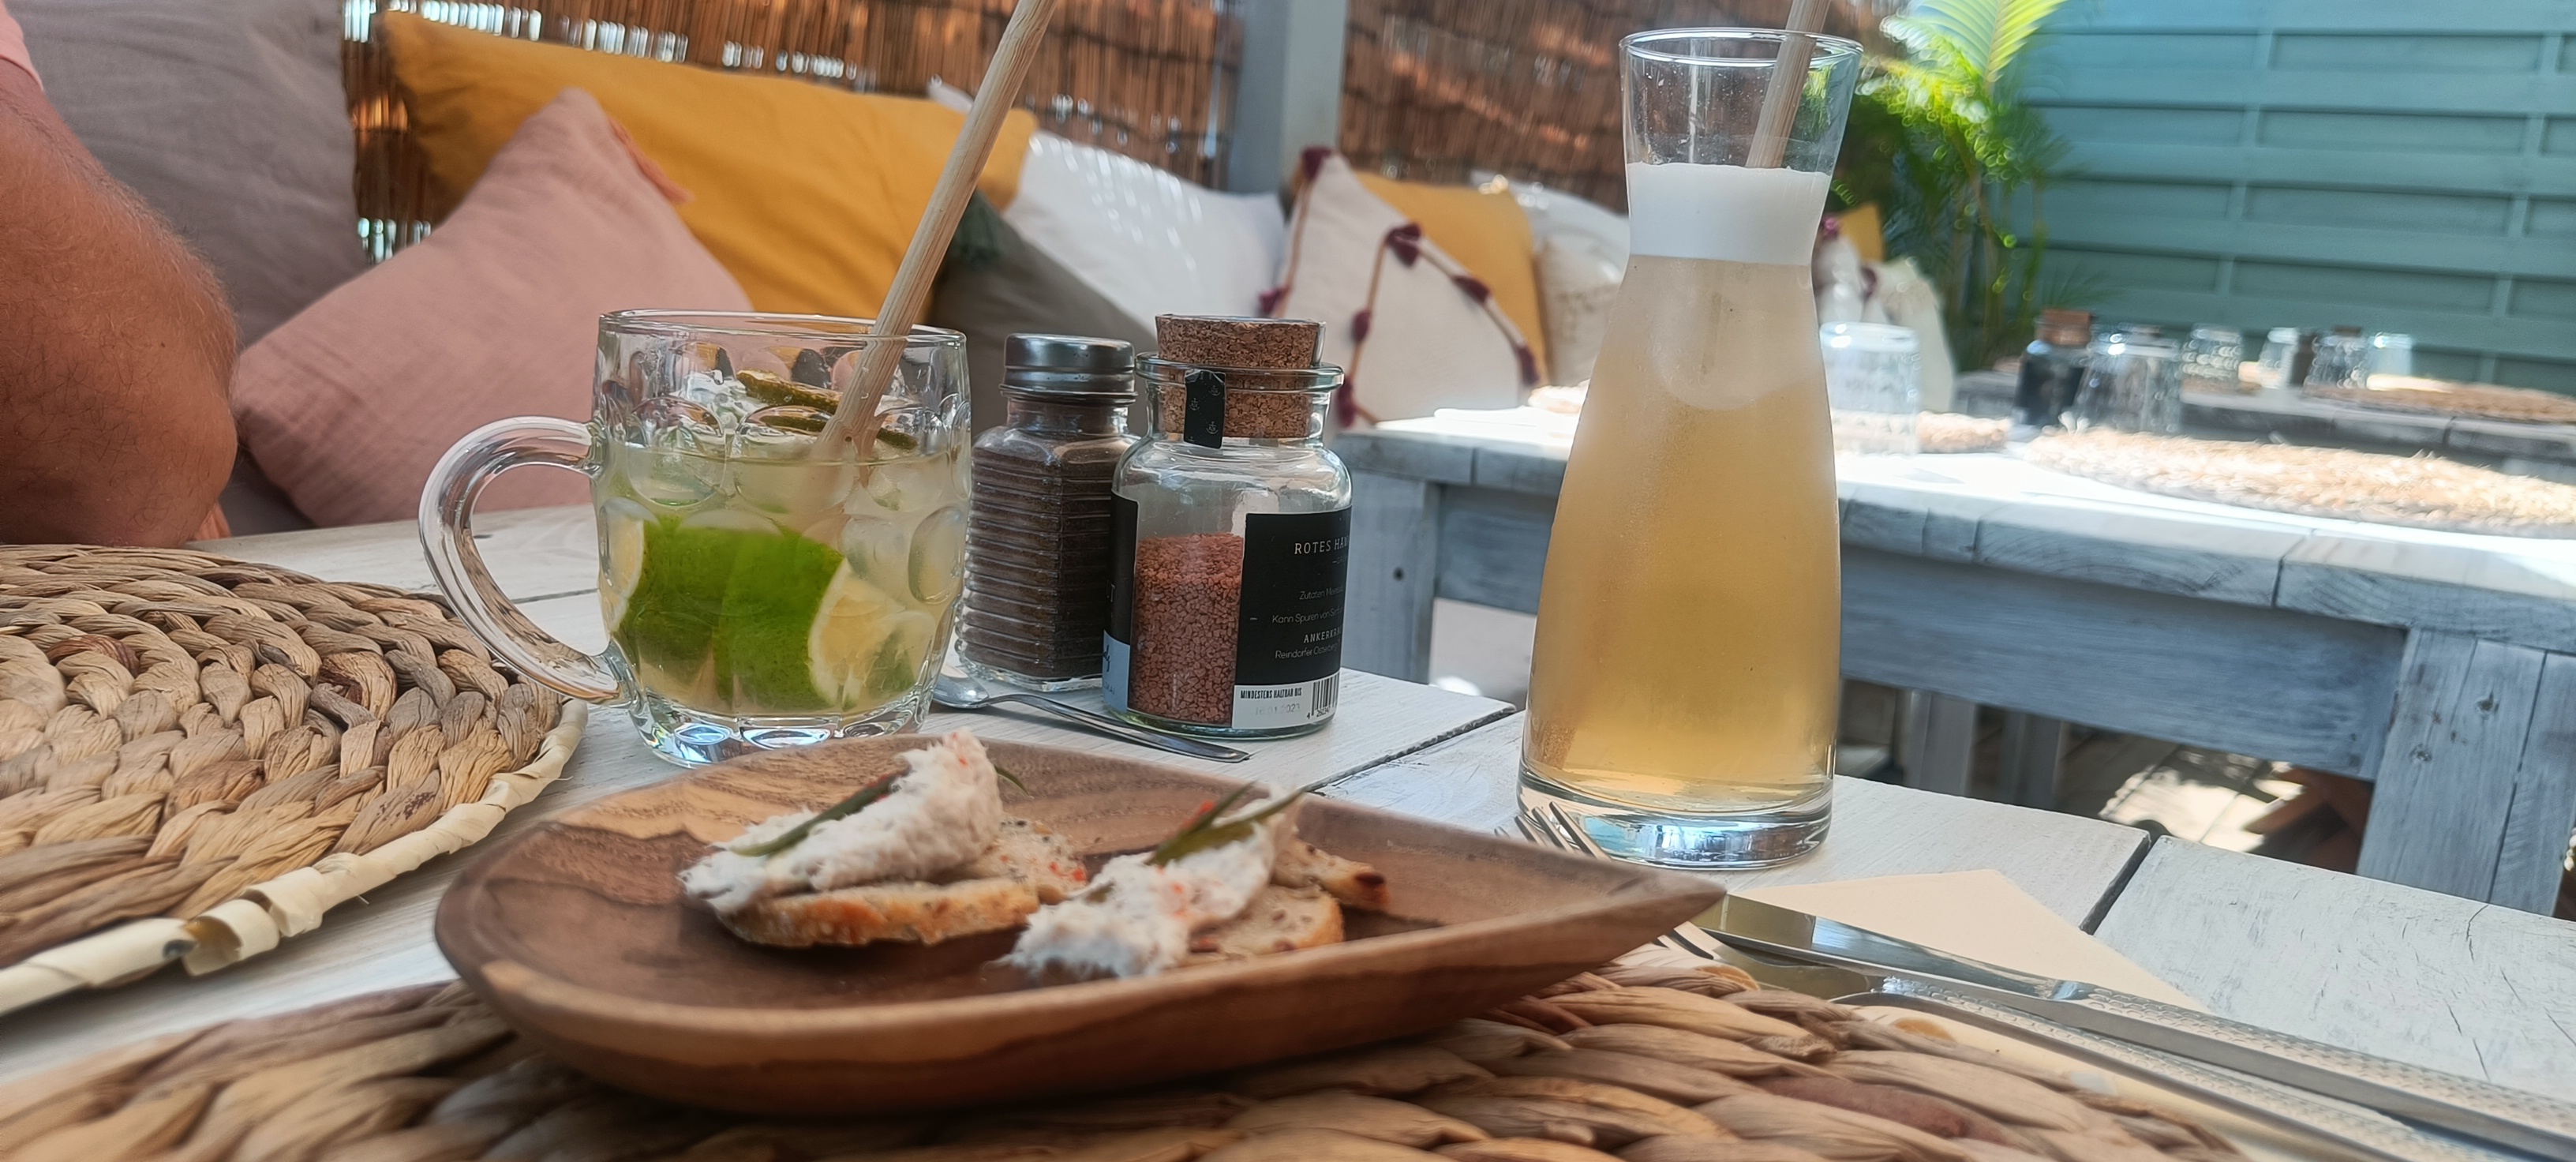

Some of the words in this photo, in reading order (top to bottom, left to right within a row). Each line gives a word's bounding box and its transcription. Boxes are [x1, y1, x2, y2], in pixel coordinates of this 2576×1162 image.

[1294, 540, 1331, 555] ROTES
[1272, 614, 1294, 624] Kann
[1295, 613, 1319, 624] Spuren
[1275, 647, 1312, 659] Reindorfer
[1241, 690, 1272, 699] MINDESTENS
[1273, 688, 1294, 699] HALTBAR
